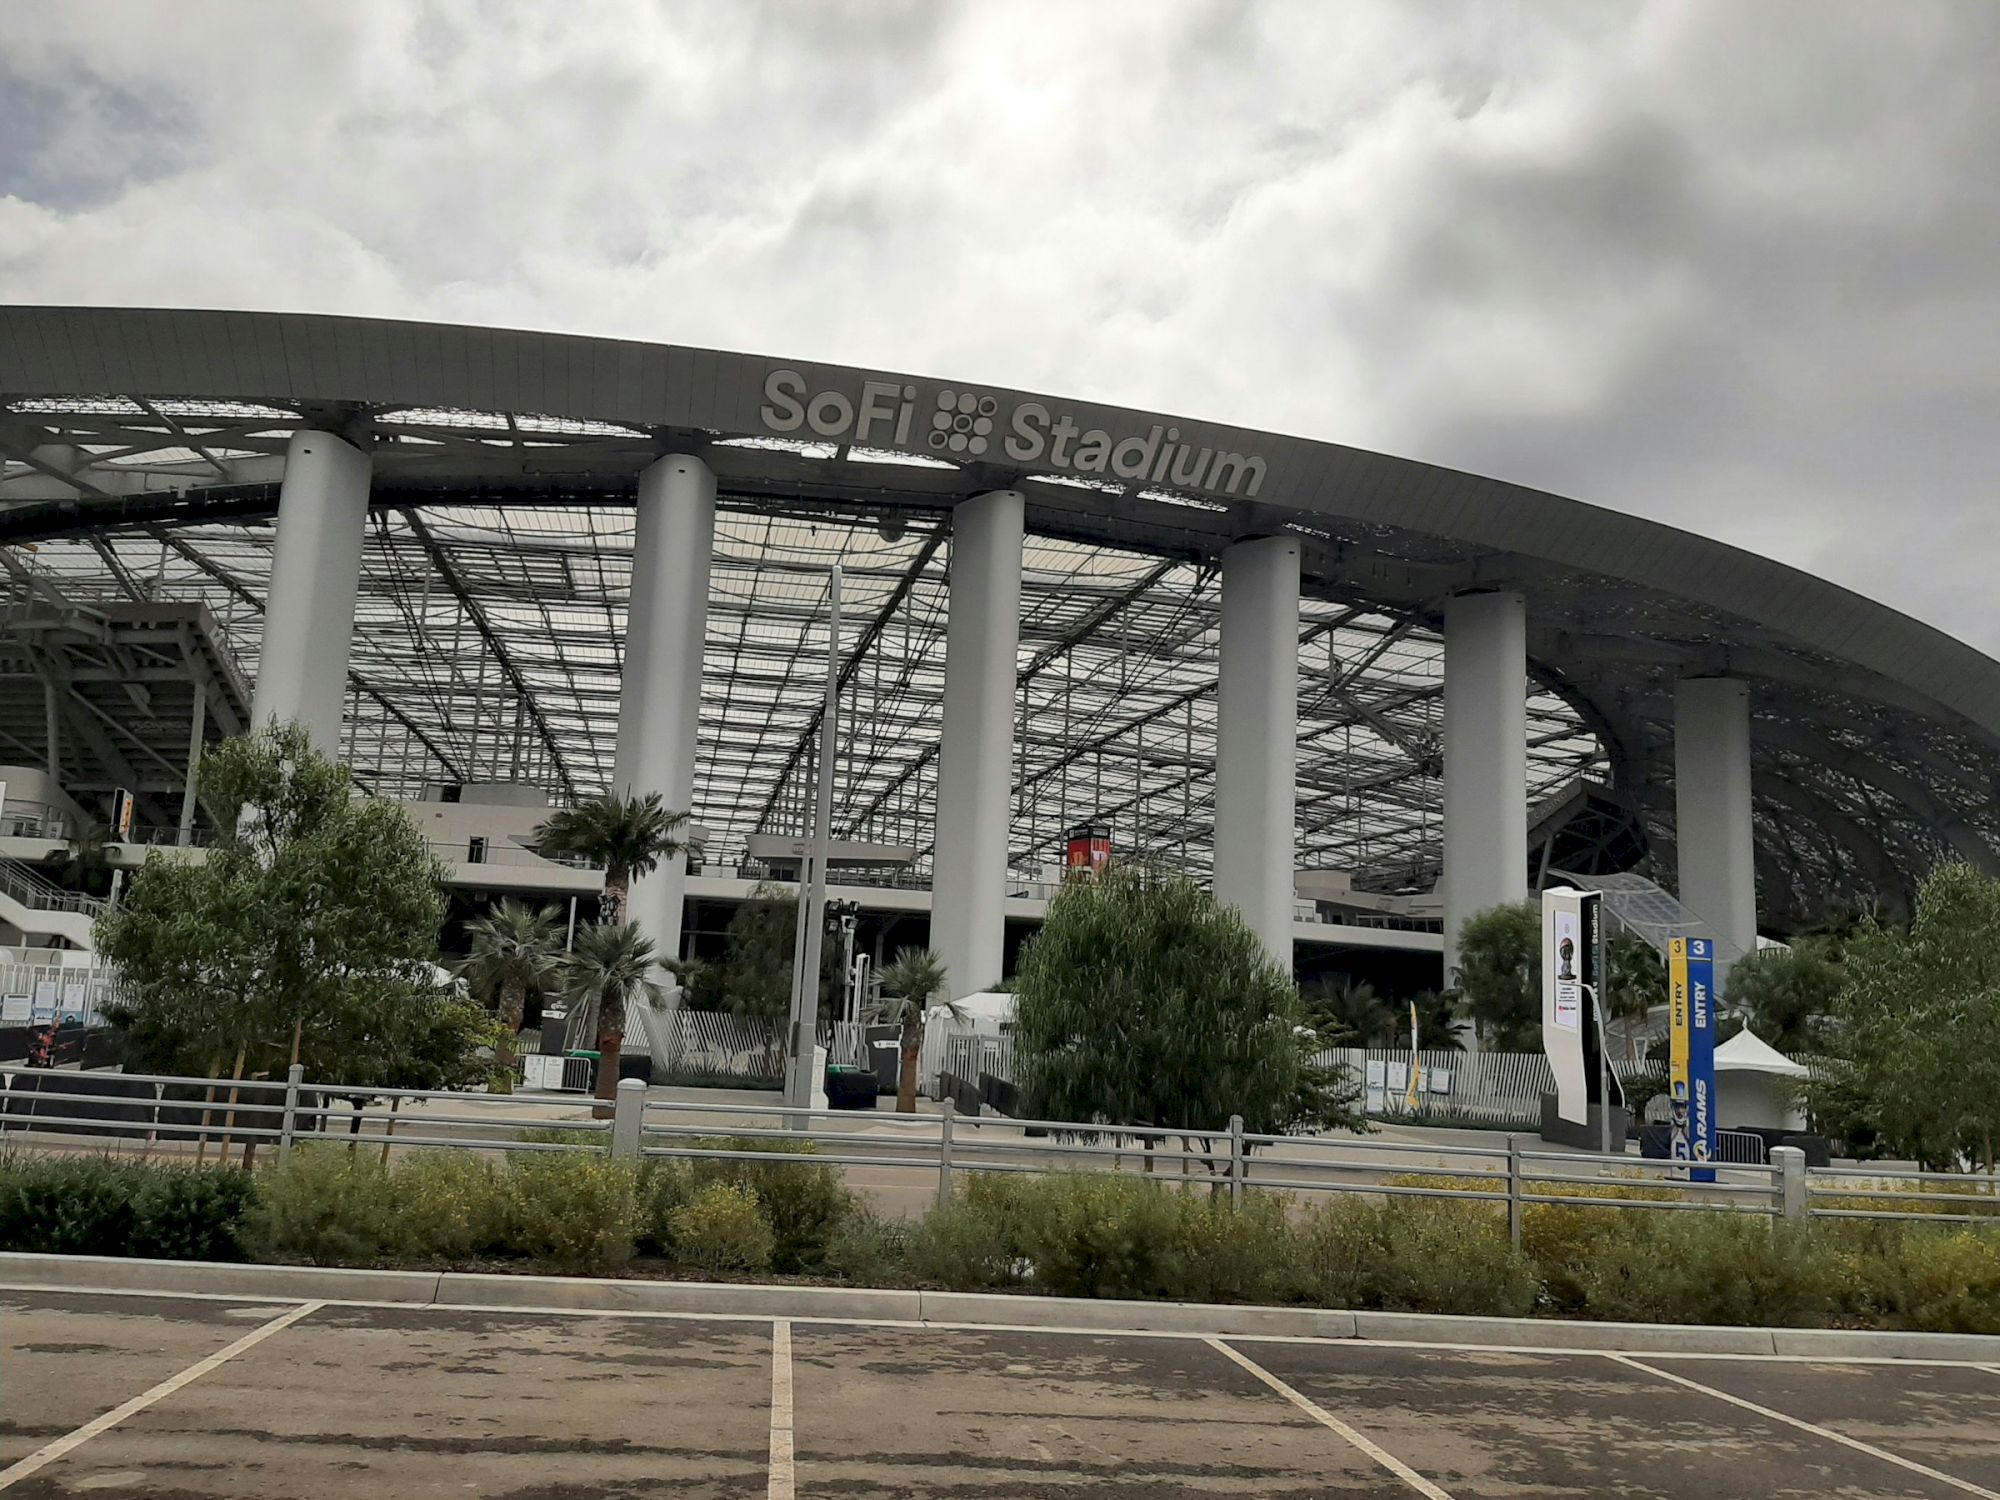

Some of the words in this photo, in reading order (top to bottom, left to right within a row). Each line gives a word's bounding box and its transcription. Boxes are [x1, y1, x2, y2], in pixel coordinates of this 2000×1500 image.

[761, 369, 917, 445] SoFi
[1004, 402, 1268, 497] Stadium
[1591, 904, 1599, 944] Stadium
[1674, 939, 1682, 954] 3
[1692, 939, 1705, 955] 3
[1674, 981, 1683, 1027] ENTRY
[1694, 980, 1707, 1029] ENTRY
[1695, 1078, 1708, 1139] RAMS
